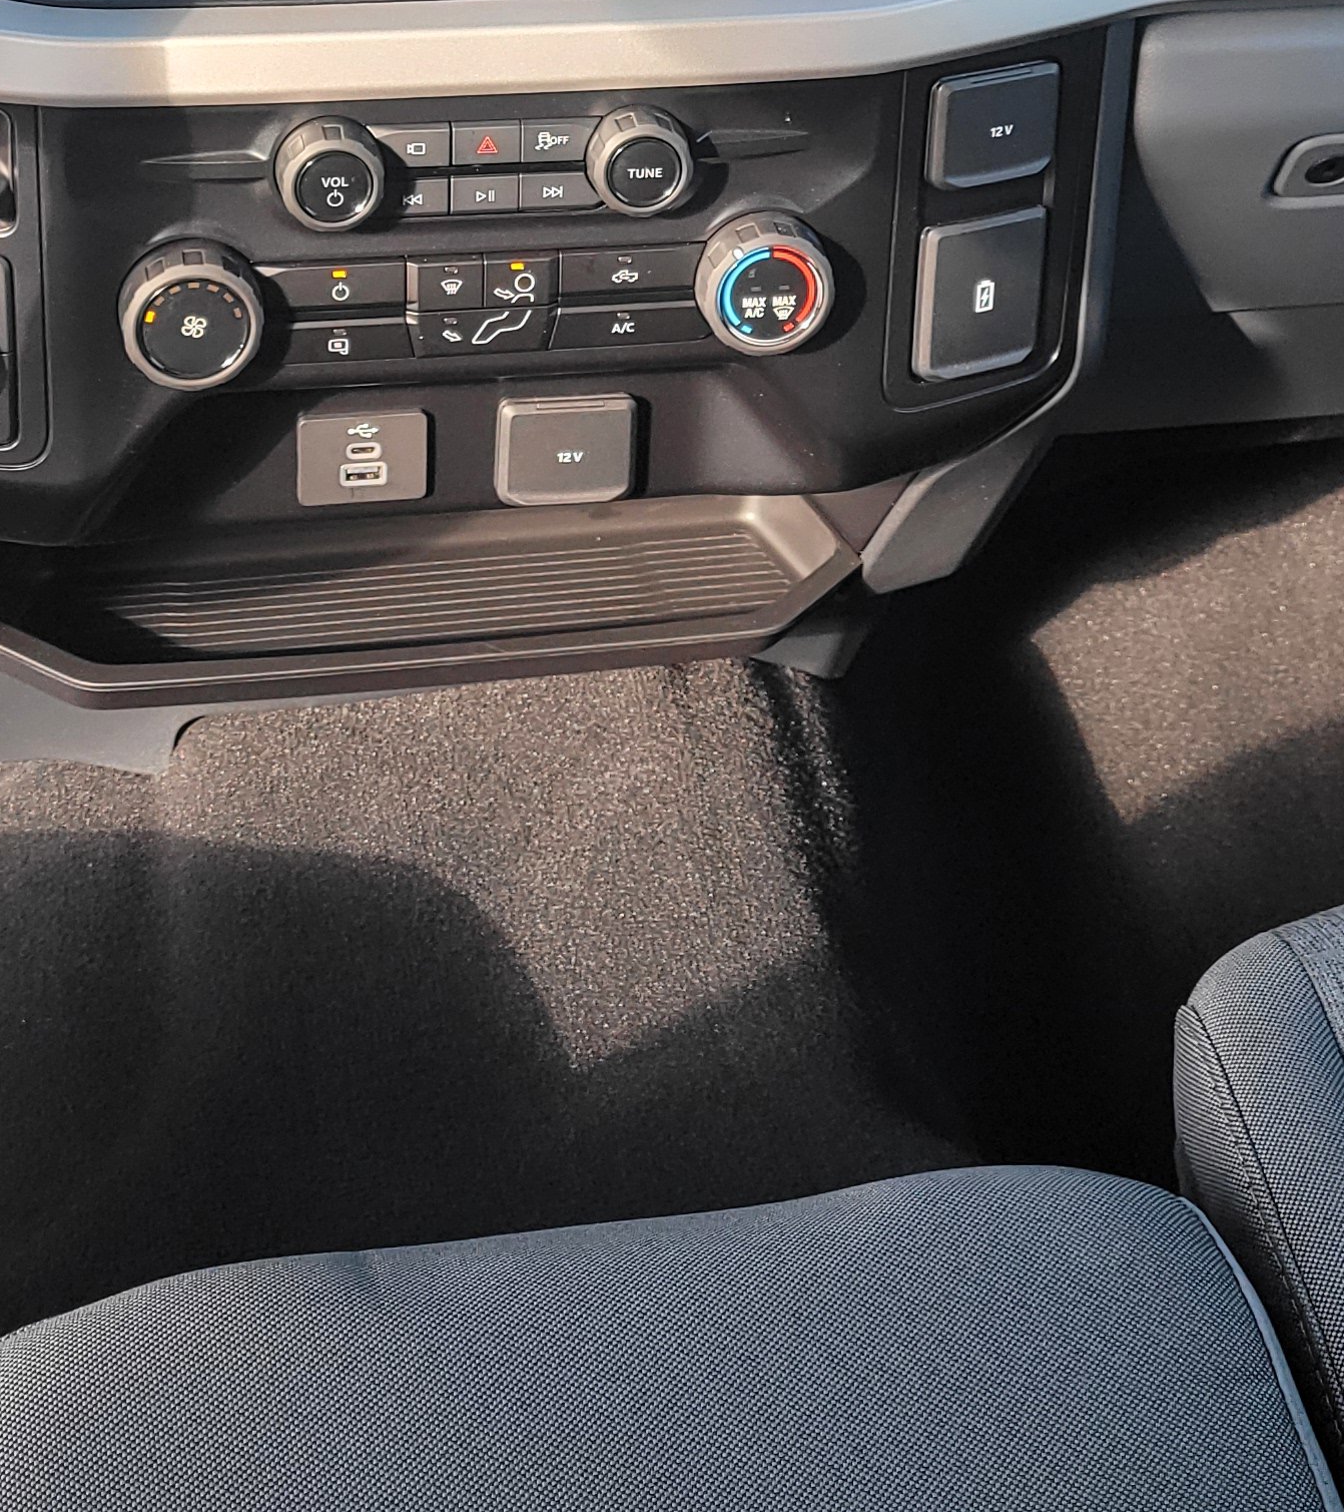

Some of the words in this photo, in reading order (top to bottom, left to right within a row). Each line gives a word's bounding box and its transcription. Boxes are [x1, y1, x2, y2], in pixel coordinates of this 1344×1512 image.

[550, 134, 570, 146] OFF
[627, 167, 663, 180] TUNE
[321, 176, 350, 189] VOL
[742, 296, 767, 308] MAX
[772, 295, 797, 307] MAX
[744, 308, 764, 319] A/C
[611, 322, 635, 334] A/C
